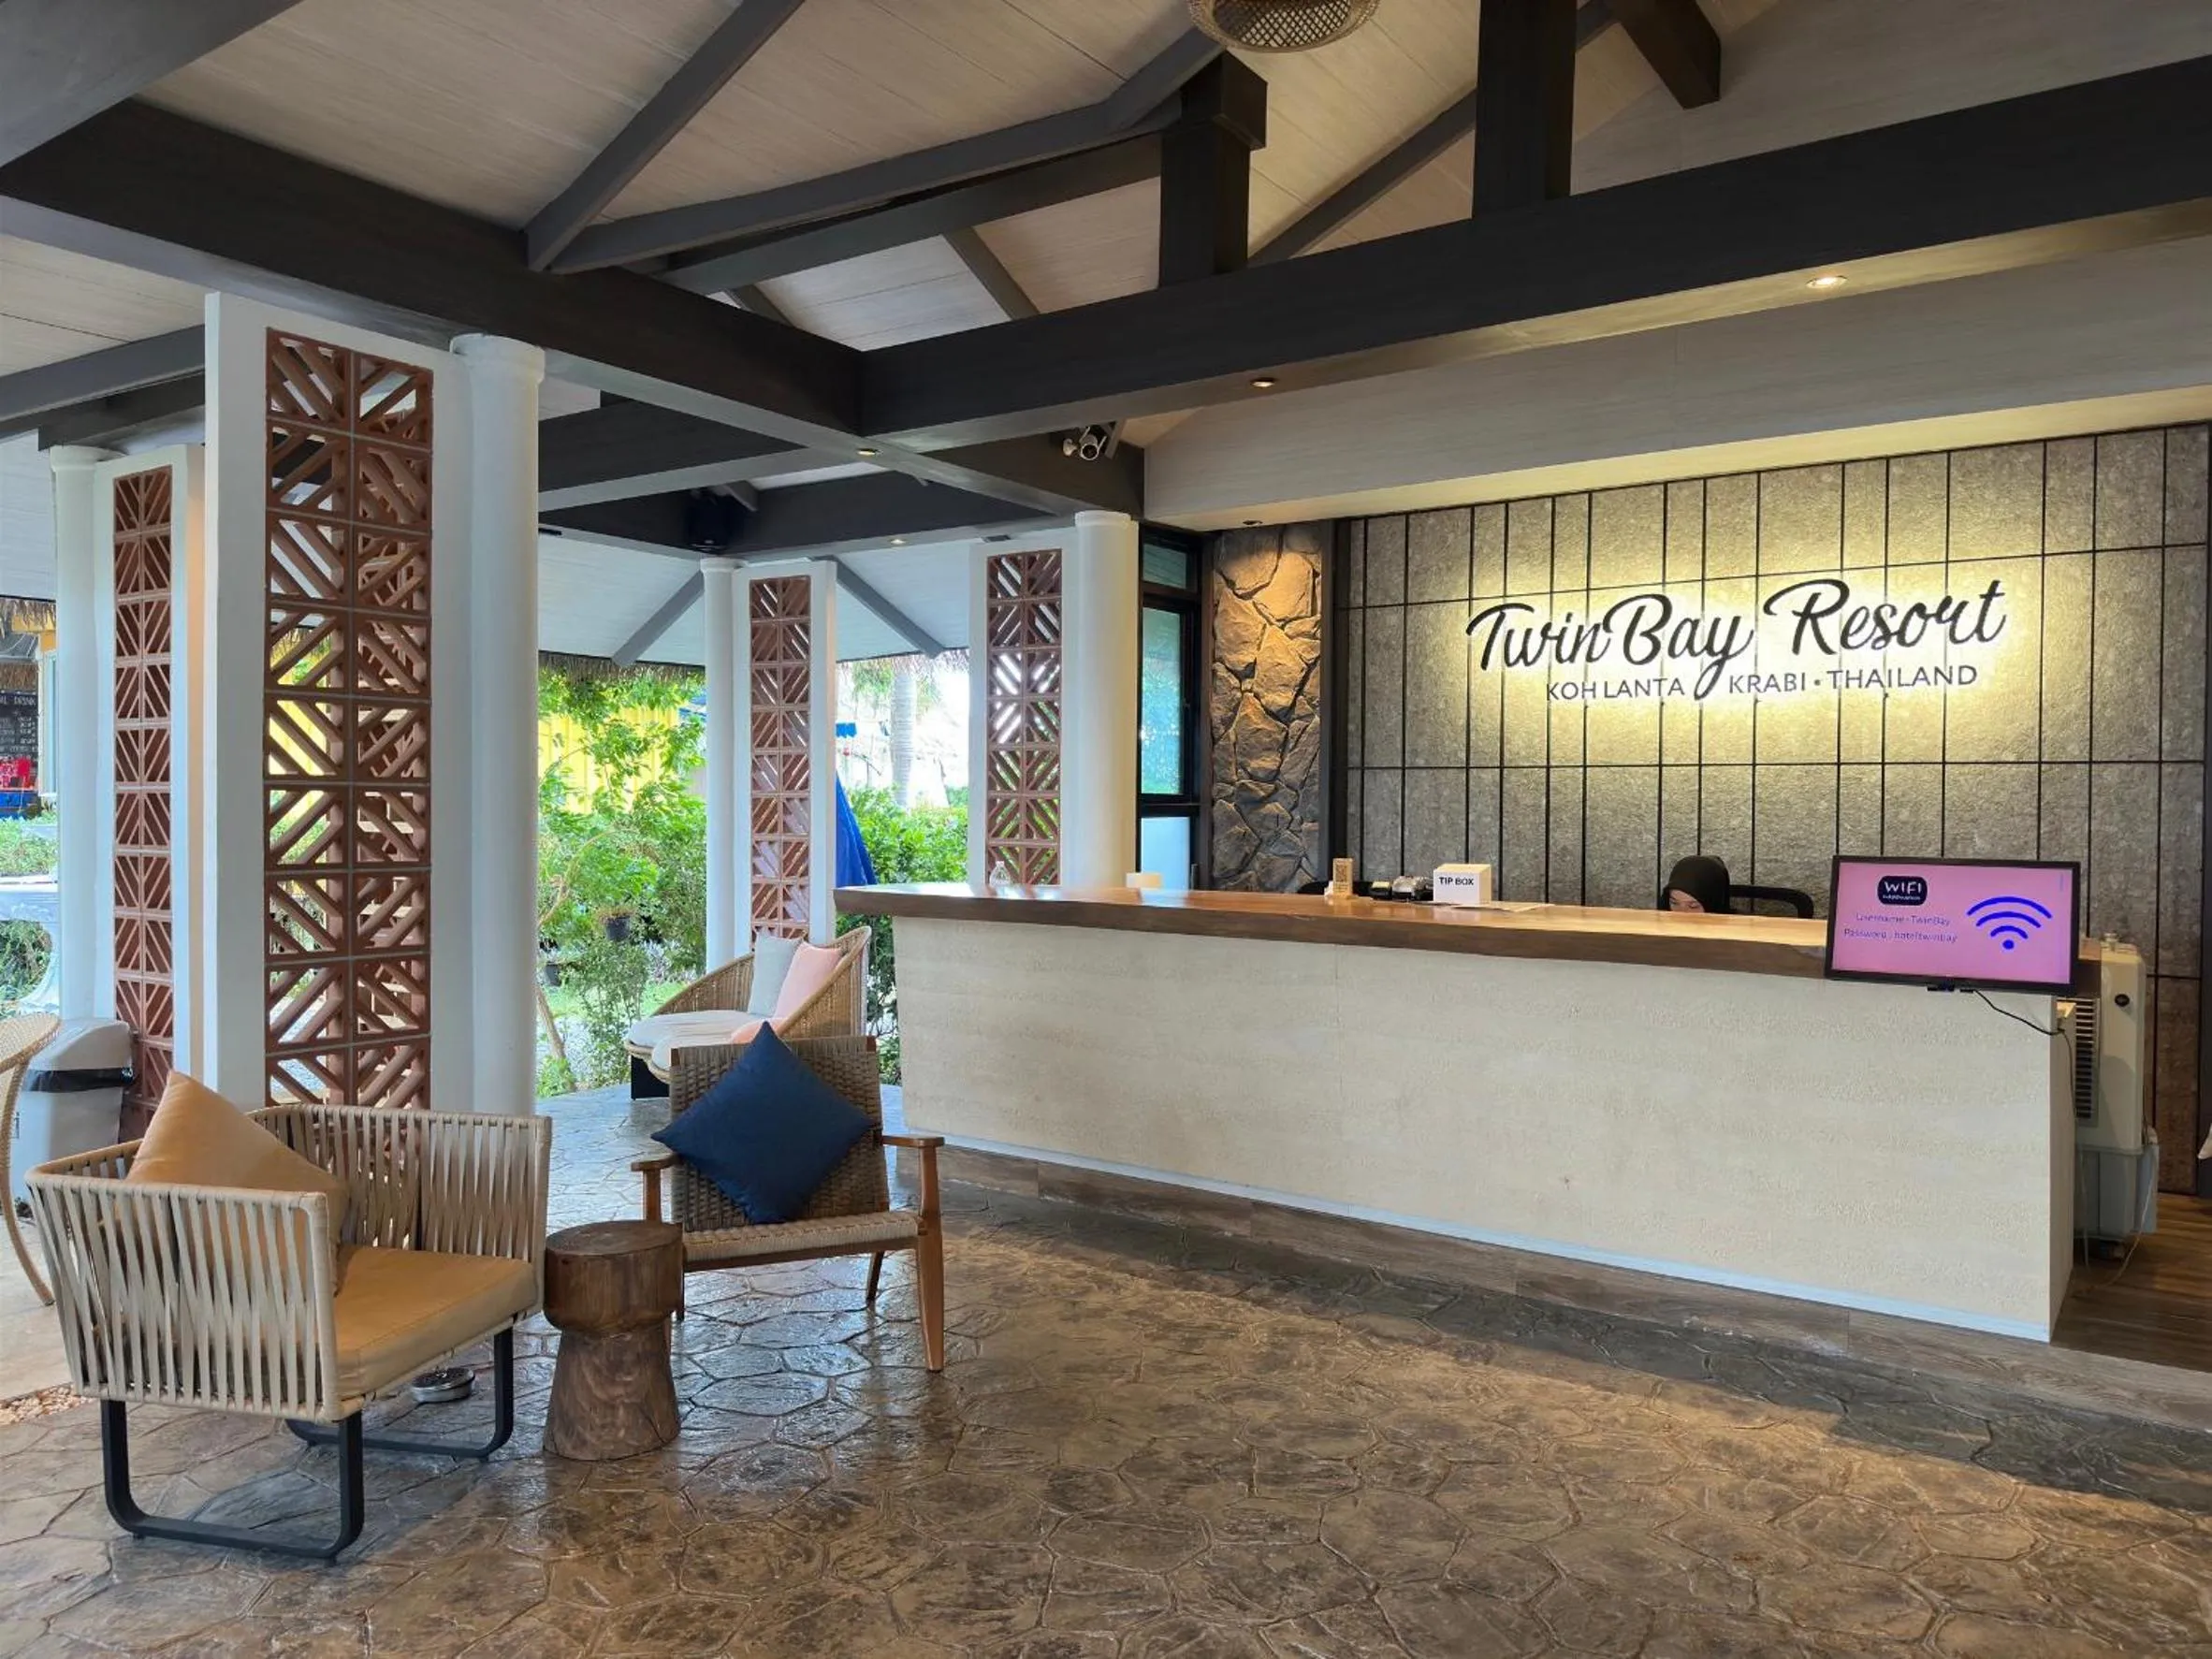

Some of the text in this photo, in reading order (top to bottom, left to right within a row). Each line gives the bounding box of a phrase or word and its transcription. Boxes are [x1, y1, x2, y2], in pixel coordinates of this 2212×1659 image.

[1763, 578, 2007, 656] Resort
[1729, 664, 1978, 694] KRABI THAILAND
[1439, 877, 1474, 886] TIP BOX
